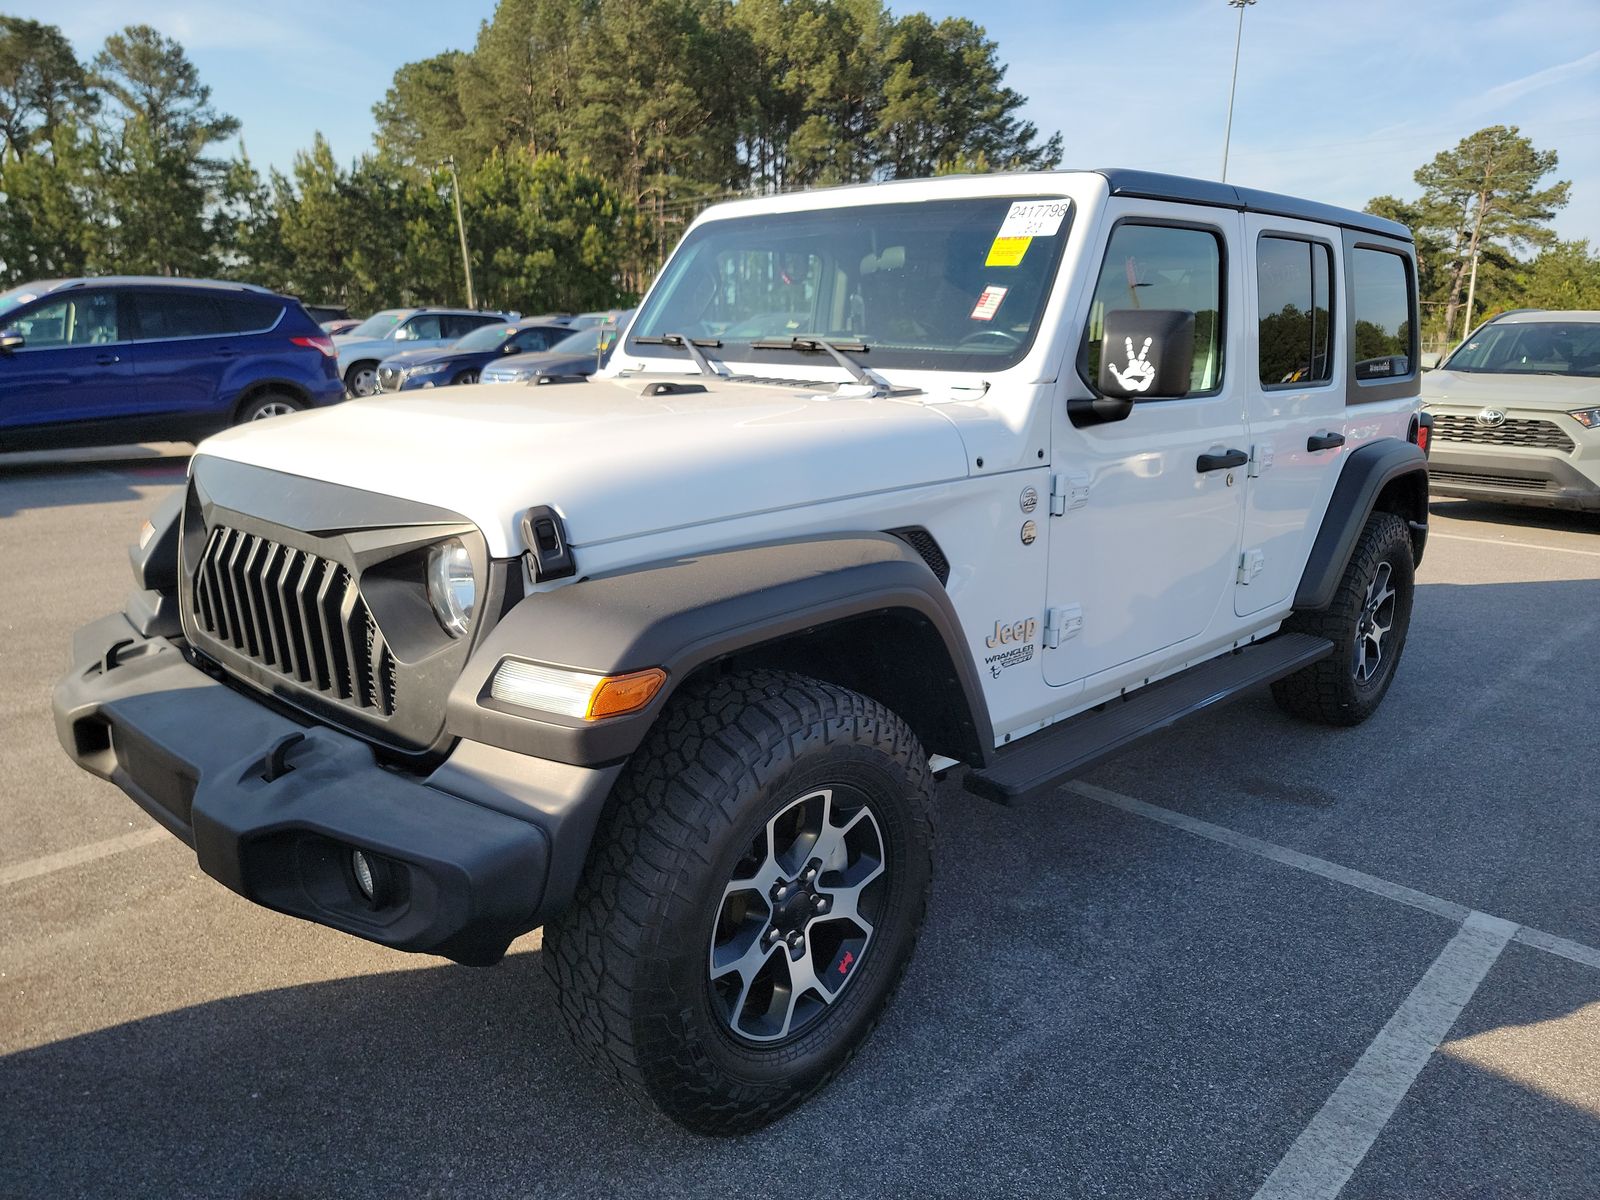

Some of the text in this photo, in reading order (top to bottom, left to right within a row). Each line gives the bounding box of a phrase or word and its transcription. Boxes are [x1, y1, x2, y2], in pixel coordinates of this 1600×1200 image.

[1010, 203, 1068, 219] 2417798
[985, 617, 1037, 648] Jeep
[984, 644, 1034, 664] WRANGLER
